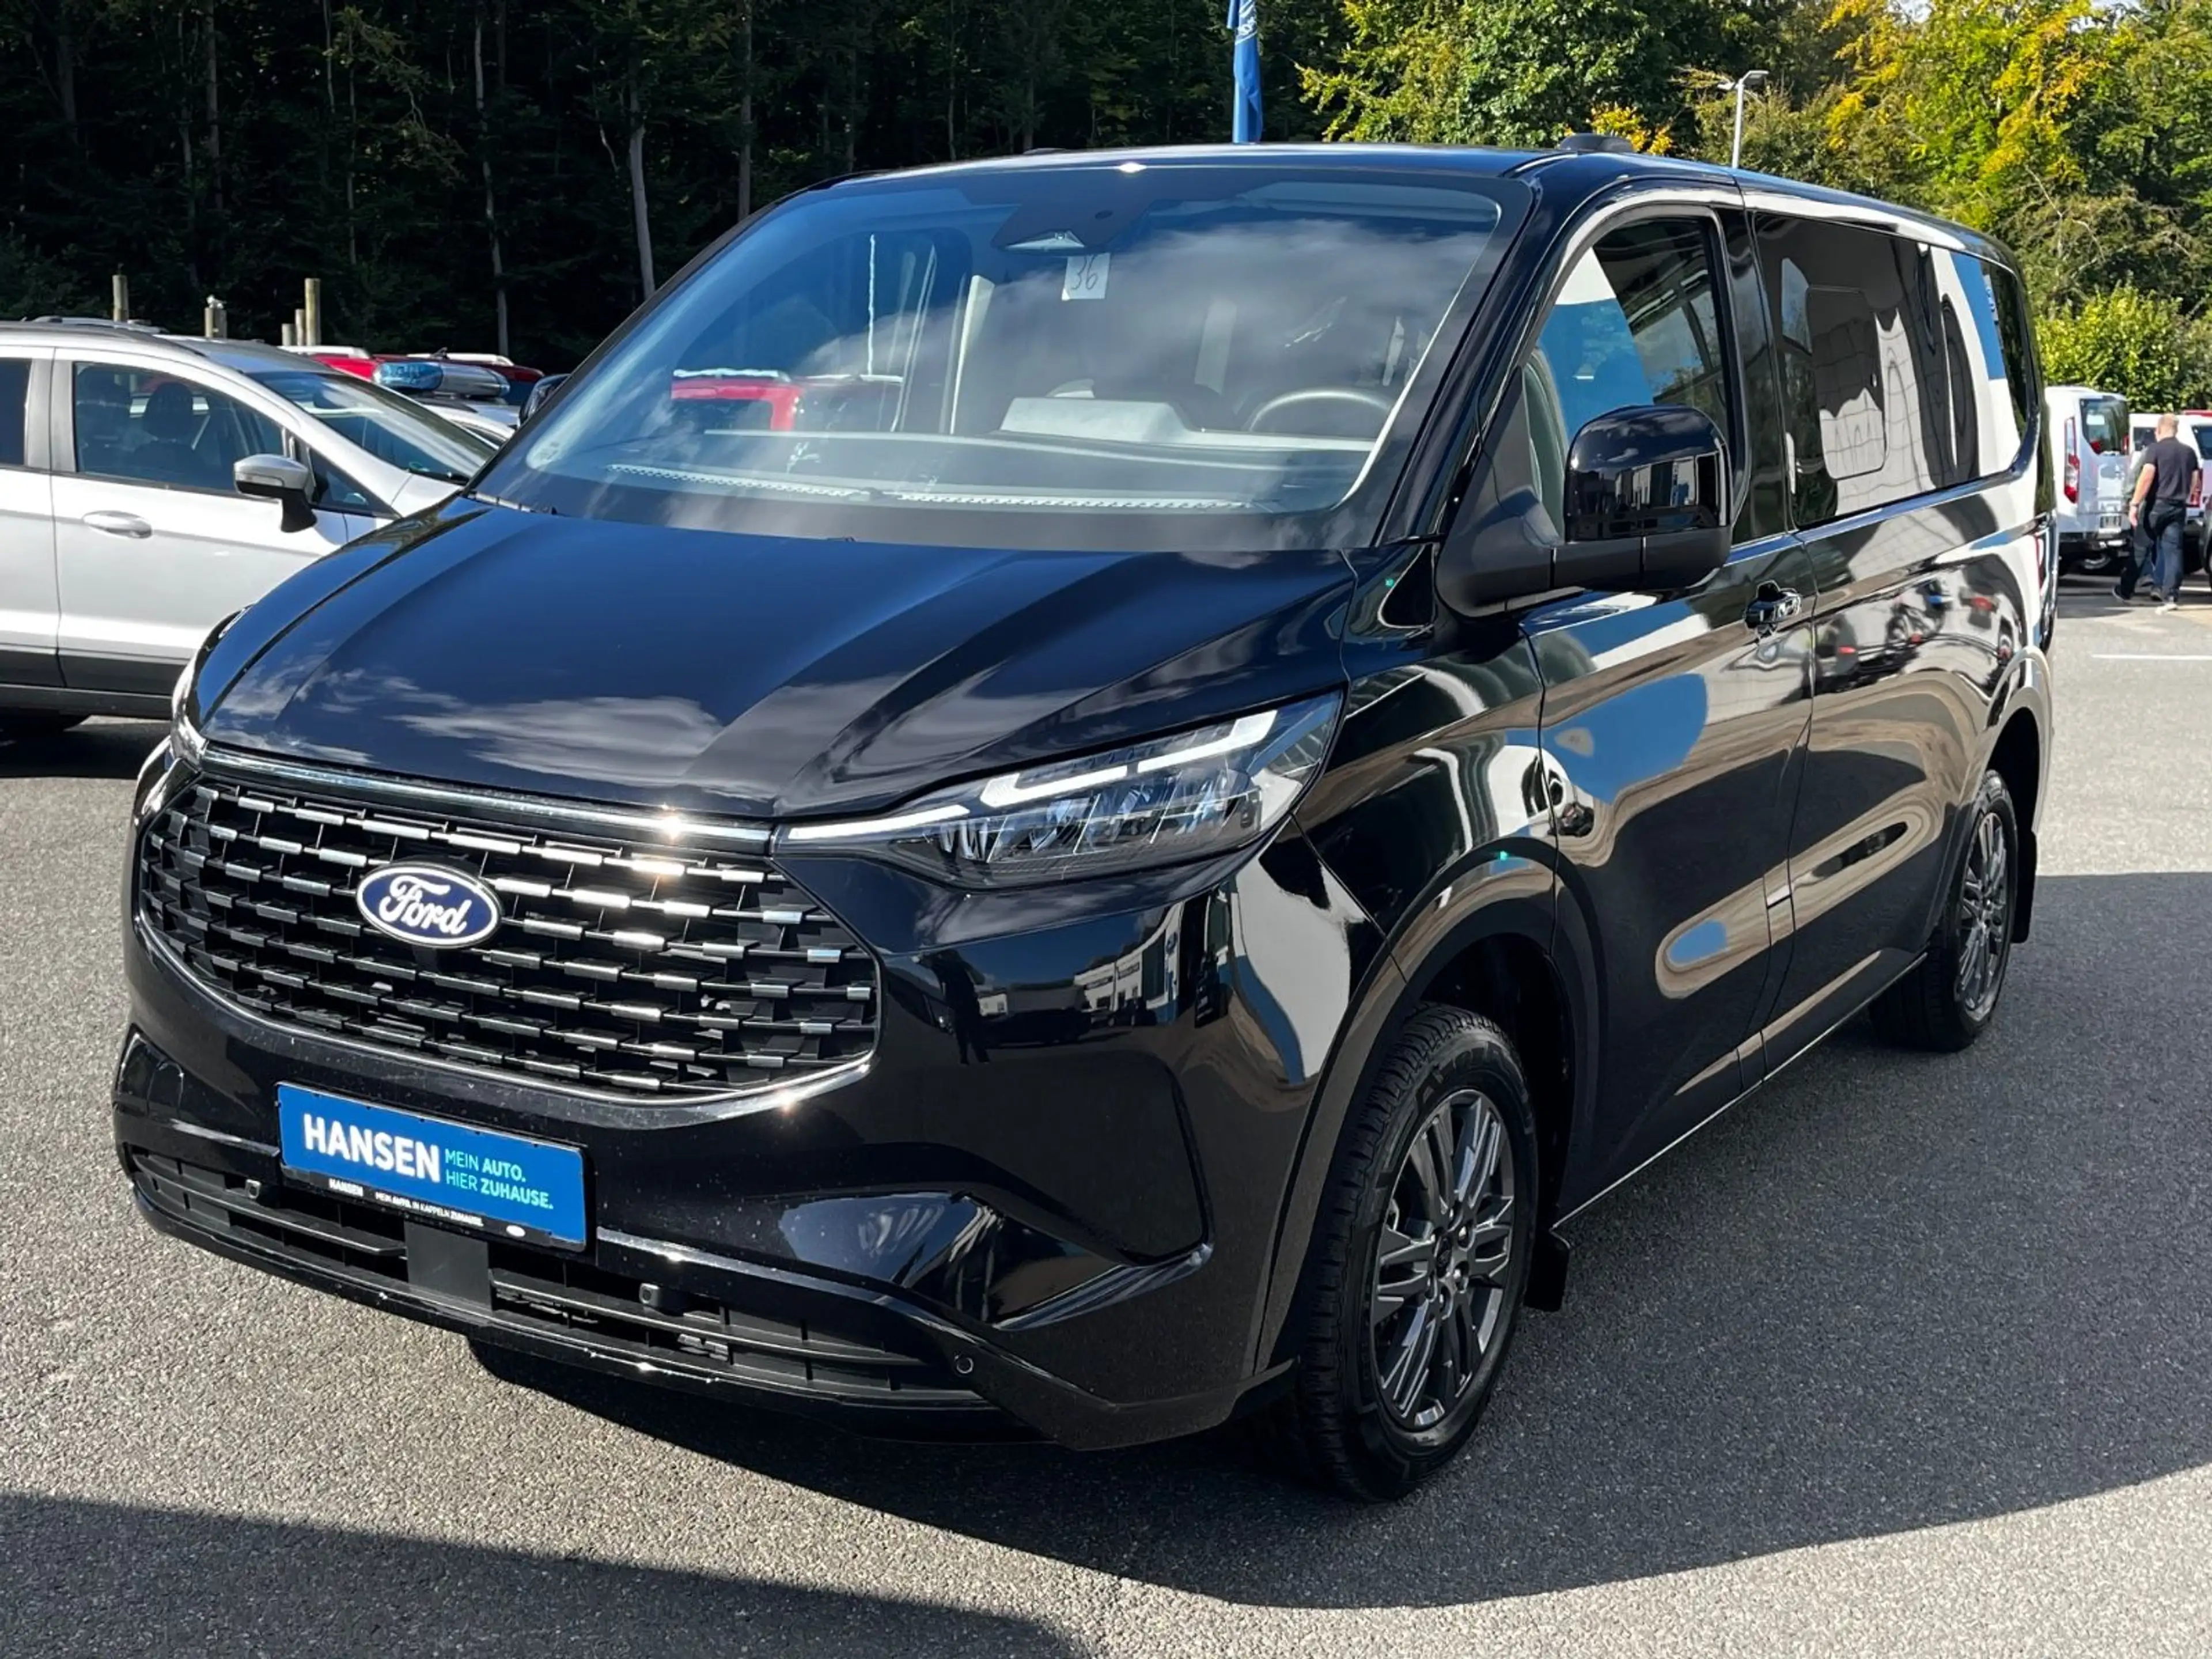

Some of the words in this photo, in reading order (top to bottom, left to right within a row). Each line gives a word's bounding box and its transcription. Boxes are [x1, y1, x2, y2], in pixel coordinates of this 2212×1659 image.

[378, 875, 472, 935] Ford
[304, 1113, 440, 1183] HANSEN
[445, 1148, 479, 1171] MEIN
[482, 1157, 527, 1183] AUTO.
[446, 1169, 478, 1192] HIER
[480, 1177, 554, 1210] ZUHAUSE.
